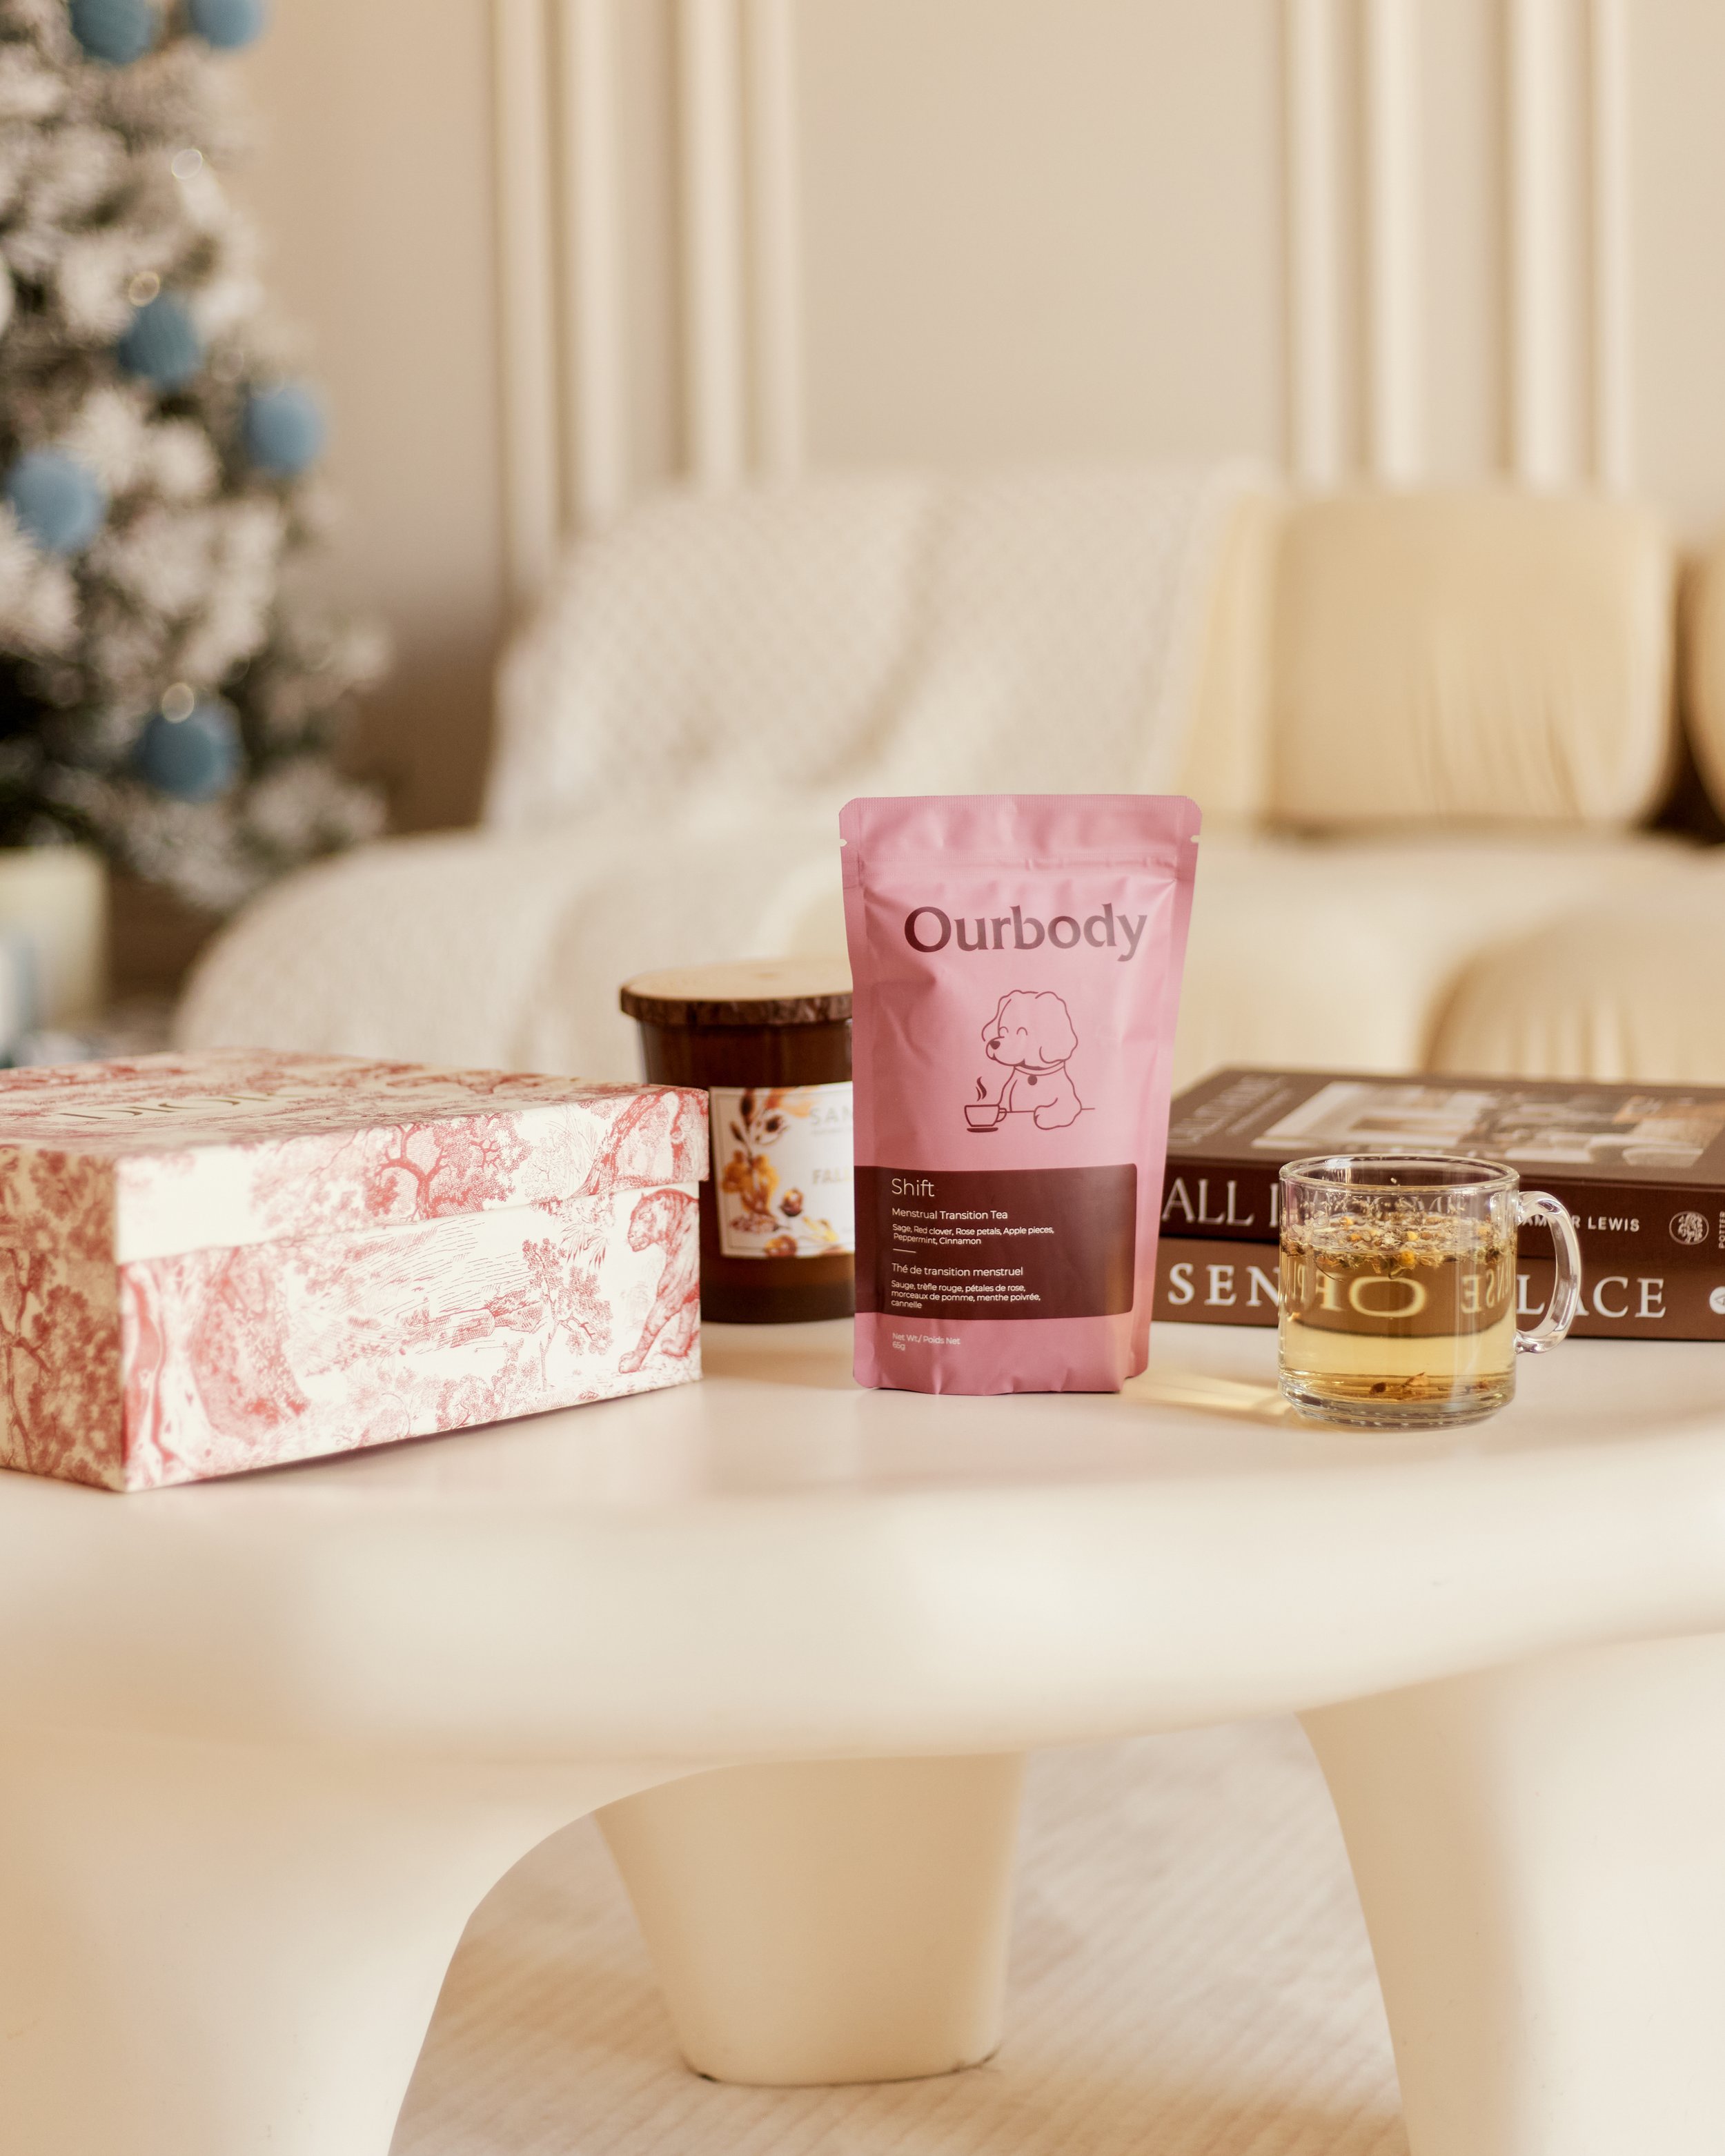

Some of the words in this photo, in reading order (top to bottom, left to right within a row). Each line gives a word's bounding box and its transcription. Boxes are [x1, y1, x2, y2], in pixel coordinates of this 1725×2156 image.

[904, 902, 1147, 962] Ourbody
[891, 1178, 935, 1197] Shift
[891, 1207, 938, 1220] Menstrual
[939, 1210, 989, 1220] Transition
[990, 1210, 1008, 1220] Tea
[1522, 1213, 1581, 1229] AMR
[1588, 1216, 1640, 1232] LEWIS
[892, 1223, 913, 1233] Sage,
[914, 1225, 927, 1234] Red
[929, 1227, 954, 1236] clover,
[976, 1227, 1002, 1236] petals,
[1003, 1227, 1027, 1236] Apple
[1027, 1226, 1054, 1236] pieces,
[894, 1232, 938, 1245] Peppermint,
[891, 1263, 908, 1273] Thé
[909, 1265, 923, 1274] de
[924, 1267, 971, 1276] transition
[973, 1267, 1023, 1276] menstruel
[891, 1280, 916, 1290] Sauge,
[916, 1283, 937, 1291] trèfle
[938, 1284, 964, 1293] rouge,
[965, 1284, 994, 1292] pétales
[891, 1290, 928, 1300] morceaux
[1010, 1293, 1041, 1302] poivrée,
[891, 1300, 923, 1308] cannelle
[892, 1332, 905, 1341] Net
[923, 1335, 944, 1344] Poids
